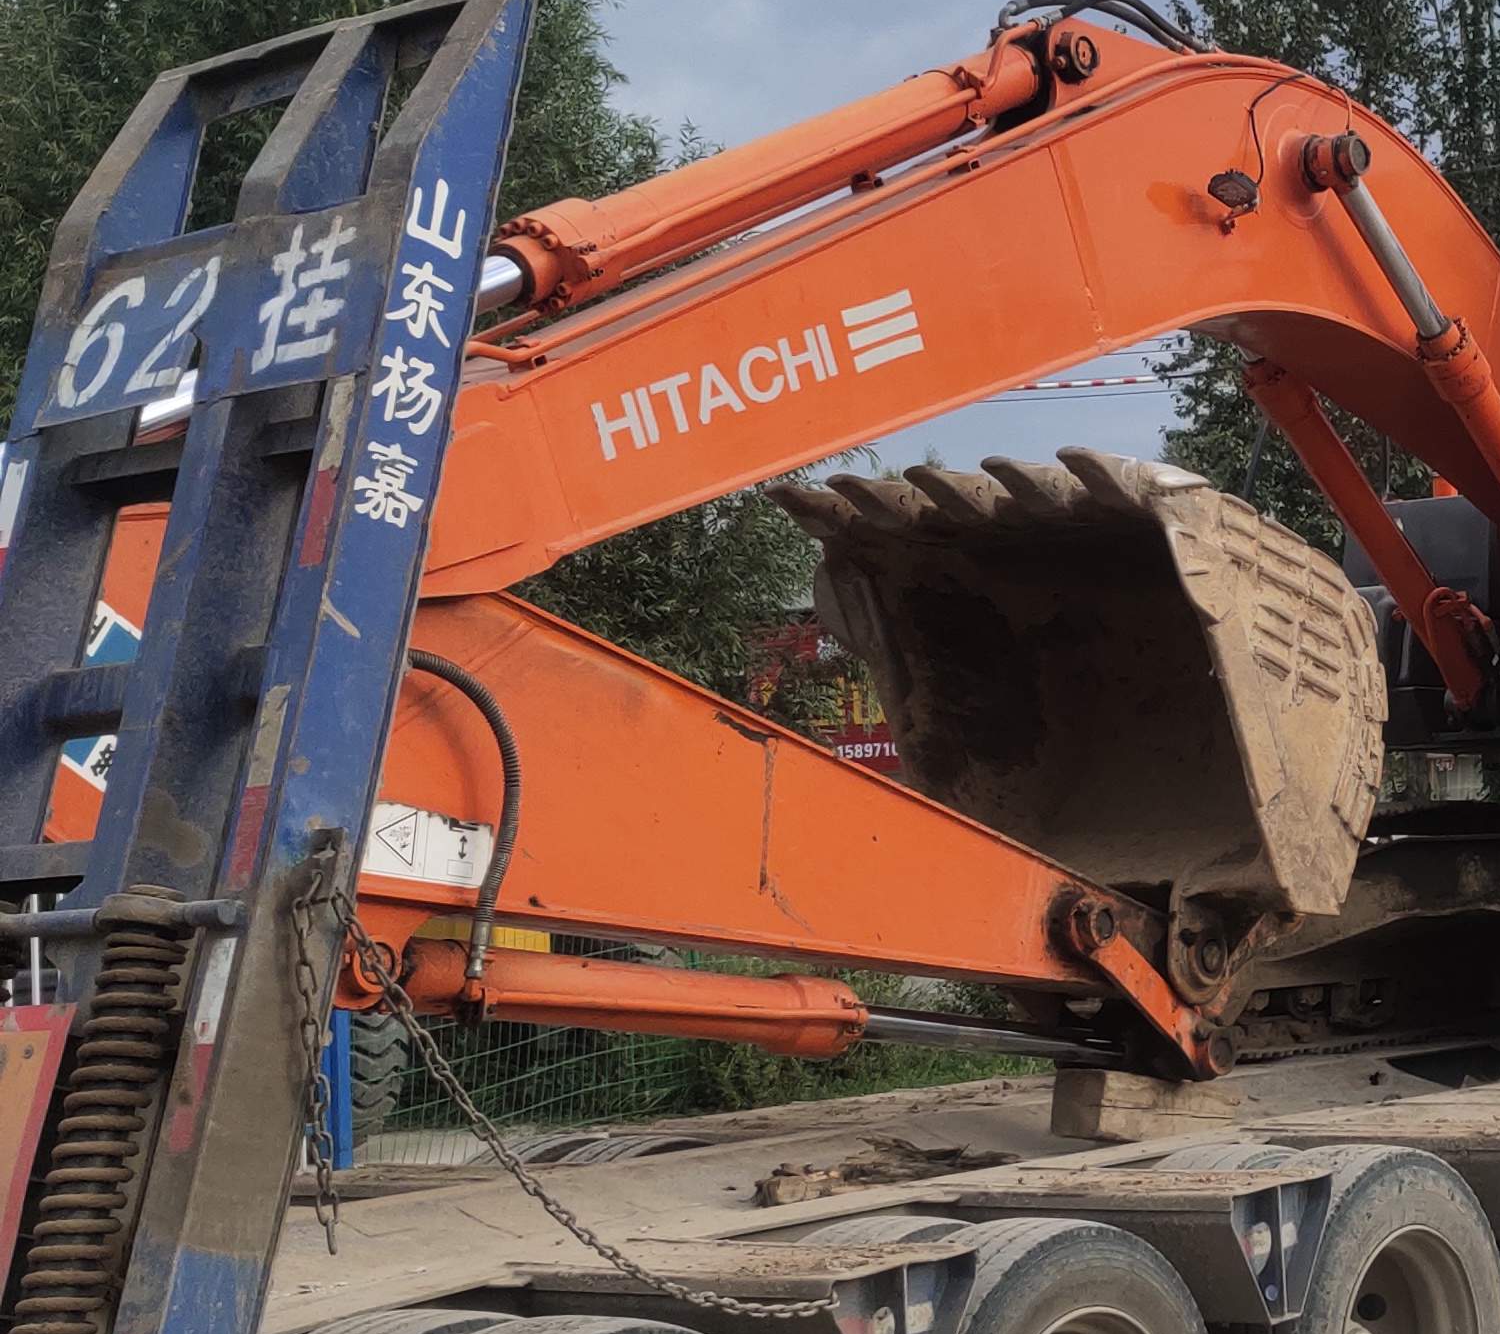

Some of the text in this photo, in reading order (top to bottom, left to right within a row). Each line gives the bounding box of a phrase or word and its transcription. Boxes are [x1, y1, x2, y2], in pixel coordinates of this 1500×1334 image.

[354, 178, 466, 529] 山东杨嘉
[589, 323, 839, 462] HITACHI
